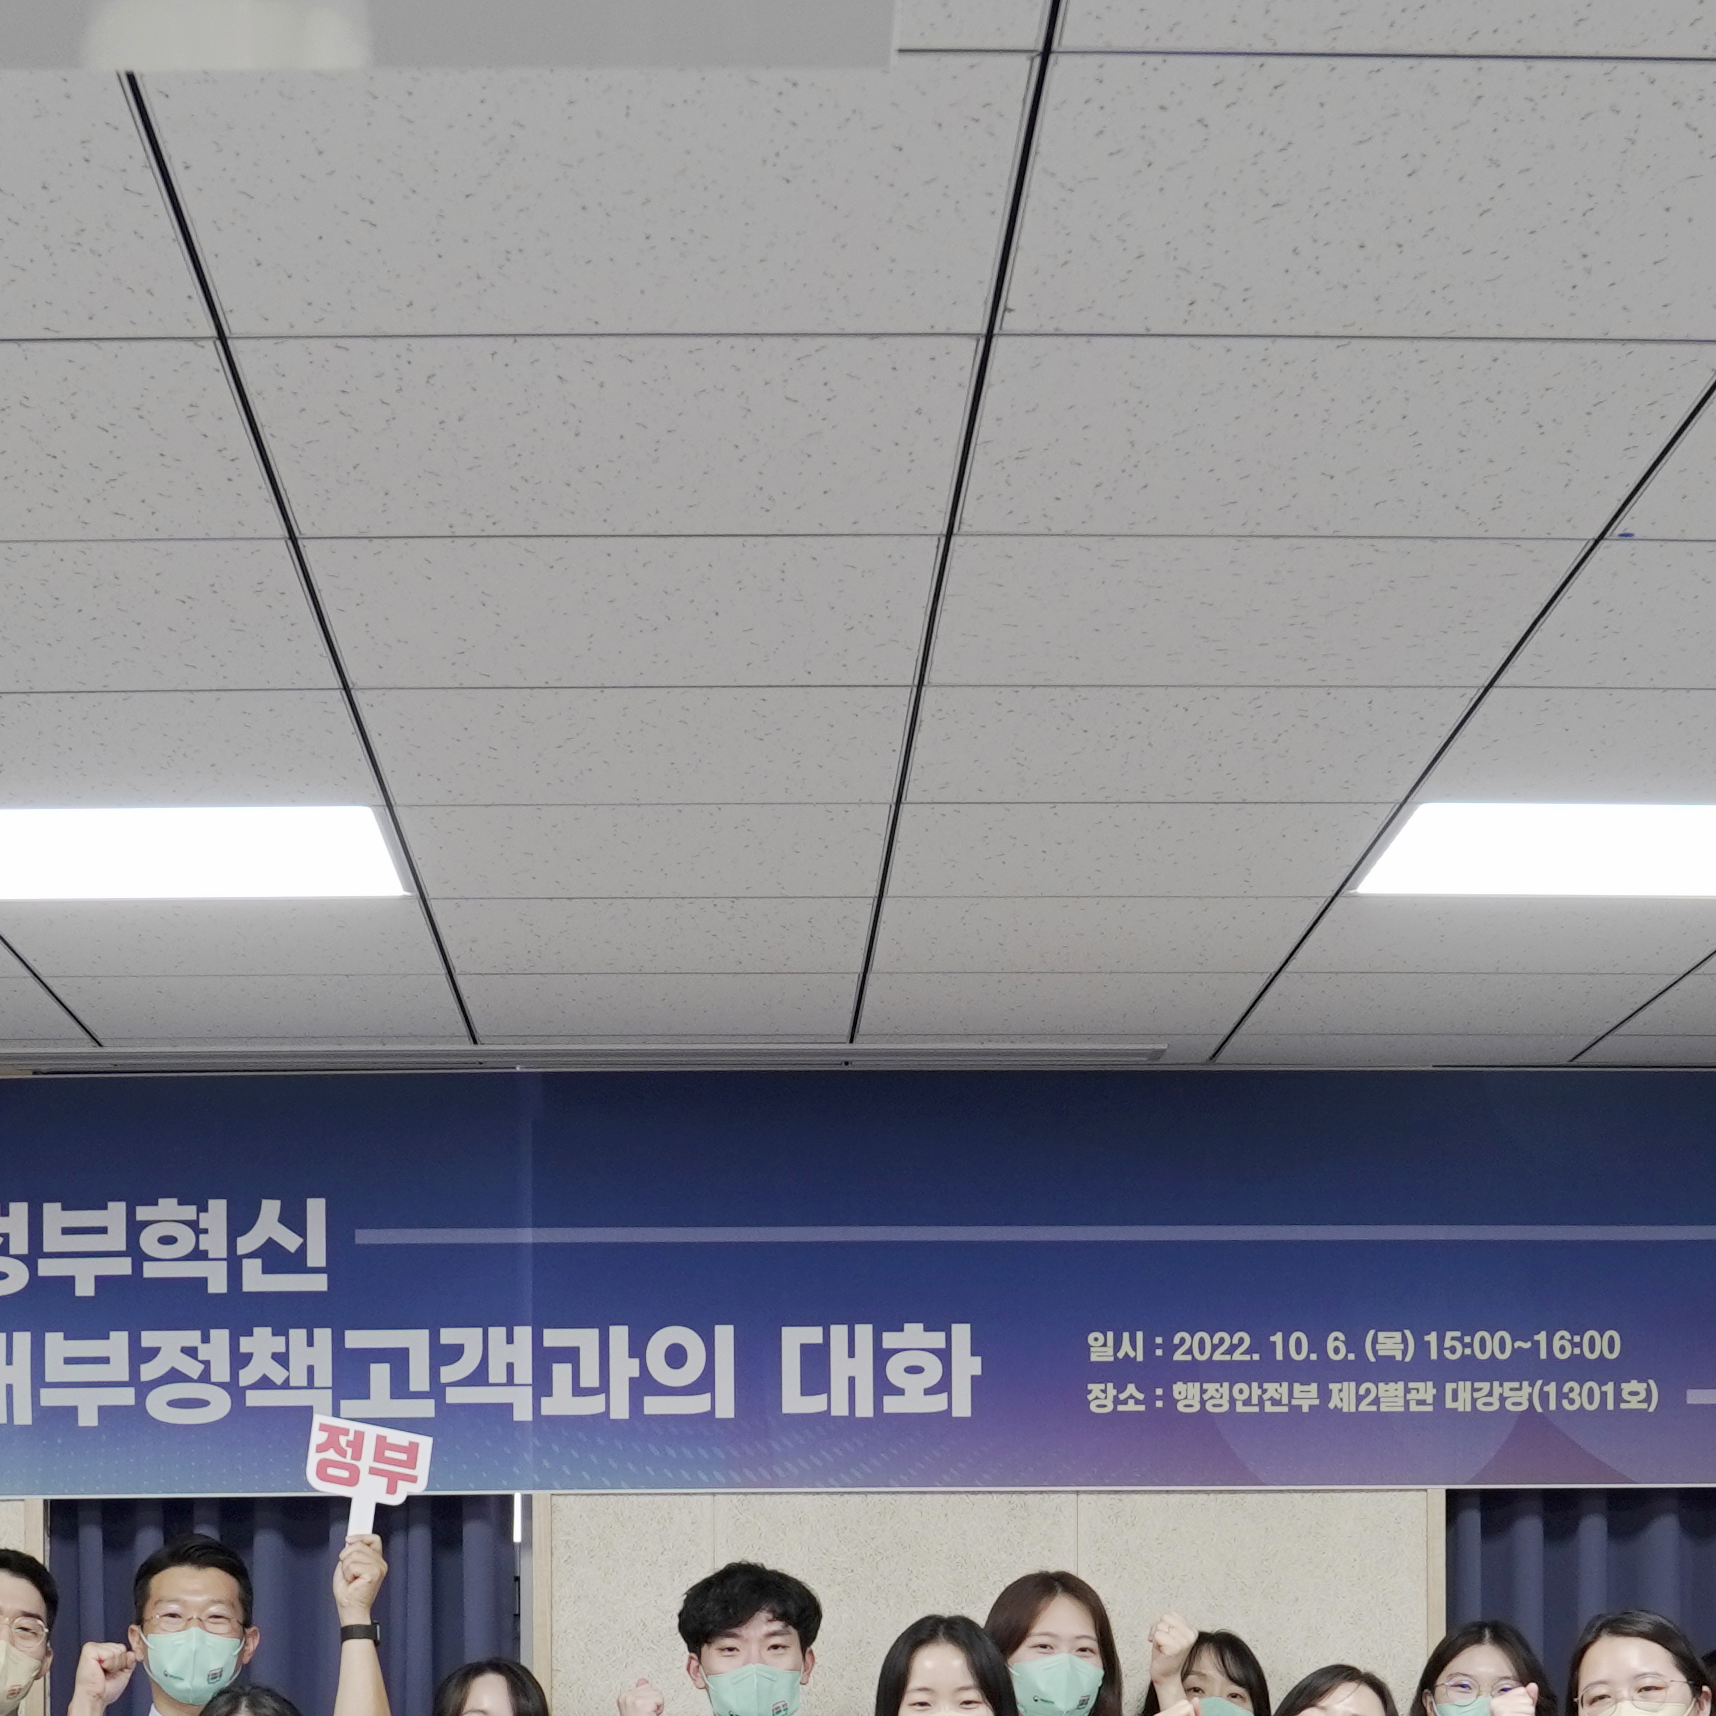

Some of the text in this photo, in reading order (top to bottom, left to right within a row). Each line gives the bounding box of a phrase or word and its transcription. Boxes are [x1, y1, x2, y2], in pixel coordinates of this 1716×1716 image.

[781, 1322, 983, 1418] 대화
[1086, 1331, 1145, 1363] 일시
[1172, 1332, 1260, 1362] 2022.
[1269, 1332, 1318, 1361] 10.
[1326, 1332, 1356, 1361] 6.
[1364, 1330, 1415, 1364] (목)
[1424, 1330, 1621, 1361] 15:00~16:00
[1086, 1382, 1146, 1414] 장소
[1172, 1381, 1320, 1414] 행정안전부
[1327, 1381, 1437, 1413] 제2별관
[1444, 1380, 1660, 1412] 대강당(1301호)
[315, 1422, 420, 1495] 정부
